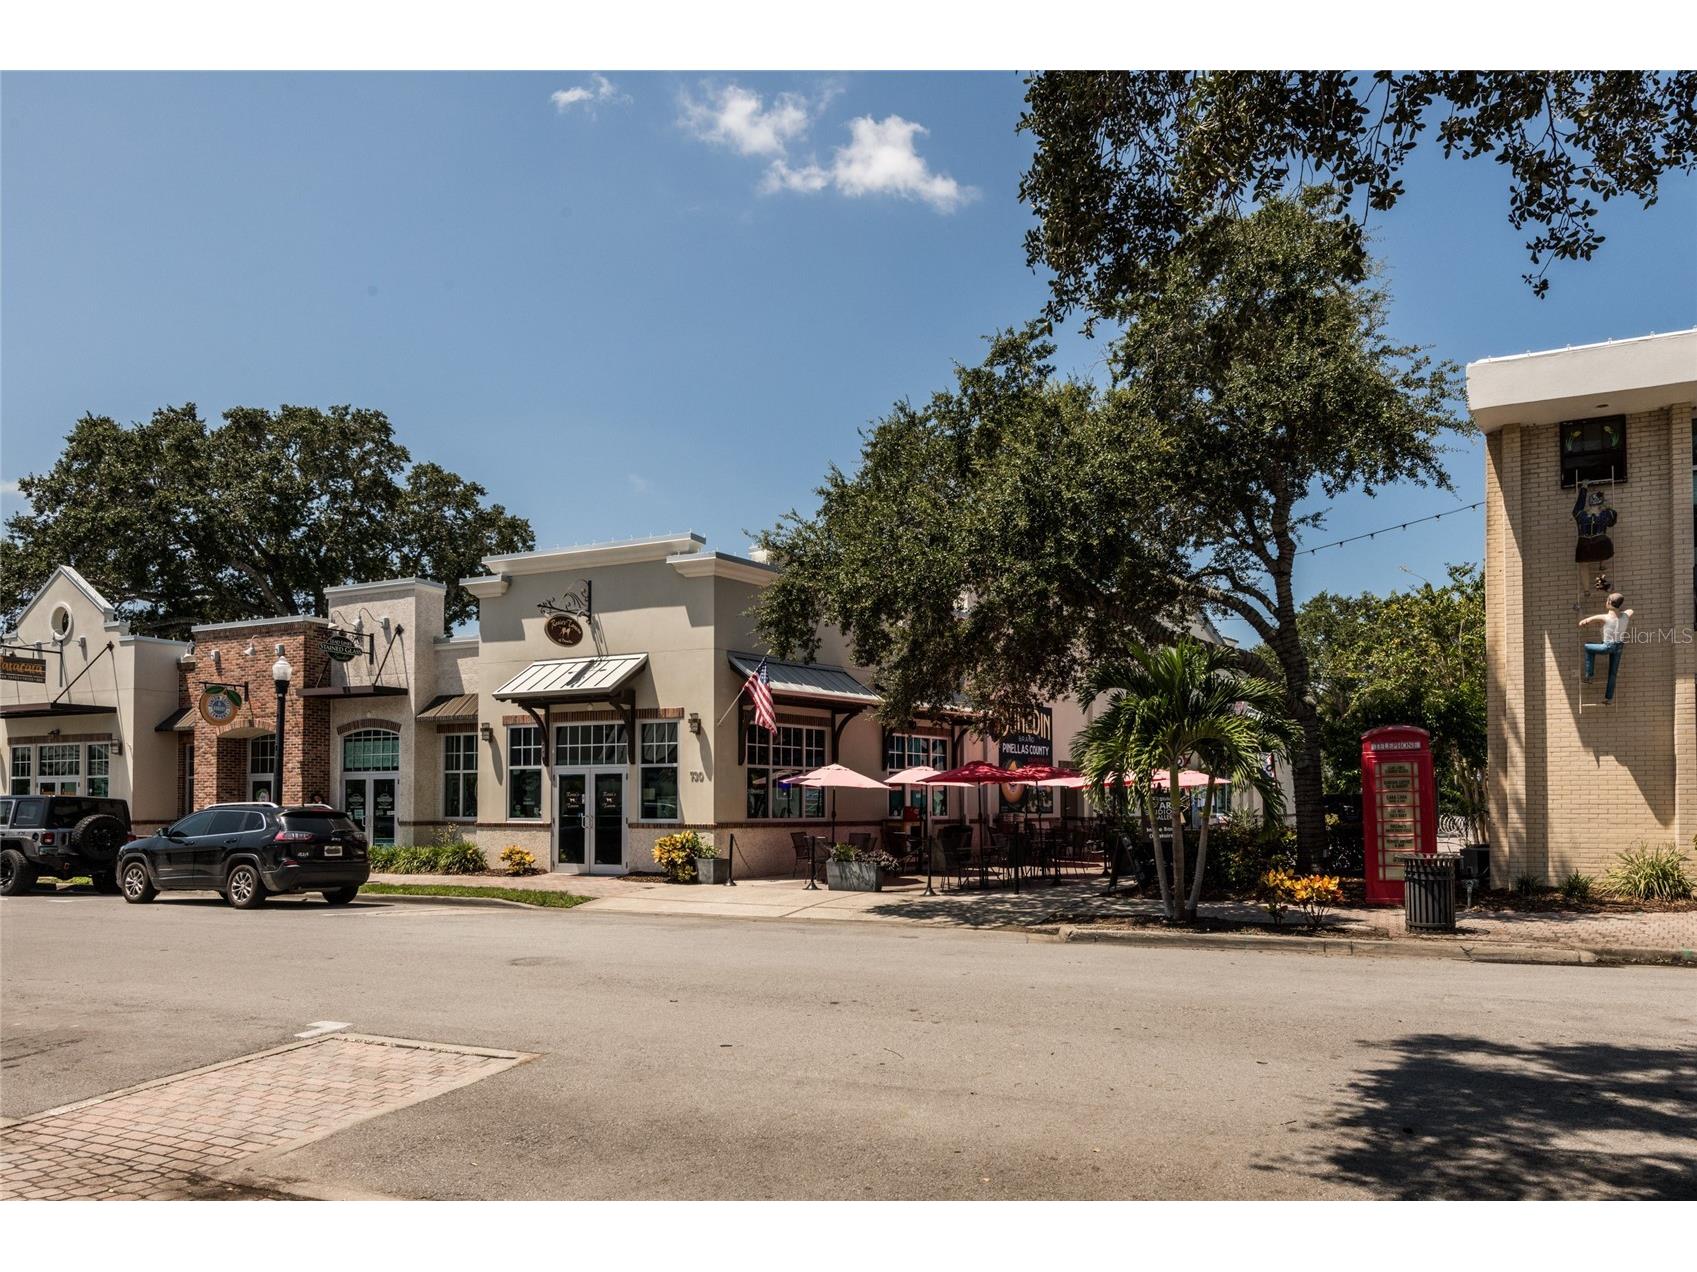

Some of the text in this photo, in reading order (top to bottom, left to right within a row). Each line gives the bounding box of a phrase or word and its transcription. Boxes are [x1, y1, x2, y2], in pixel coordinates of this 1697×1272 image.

[320, 642, 362, 655] STAINED GLASS
[1003, 742, 1050, 755] PINELLAS COUNTY
[1372, 742, 1420, 750] TELEPHONE
[690, 771, 704, 783] 730
